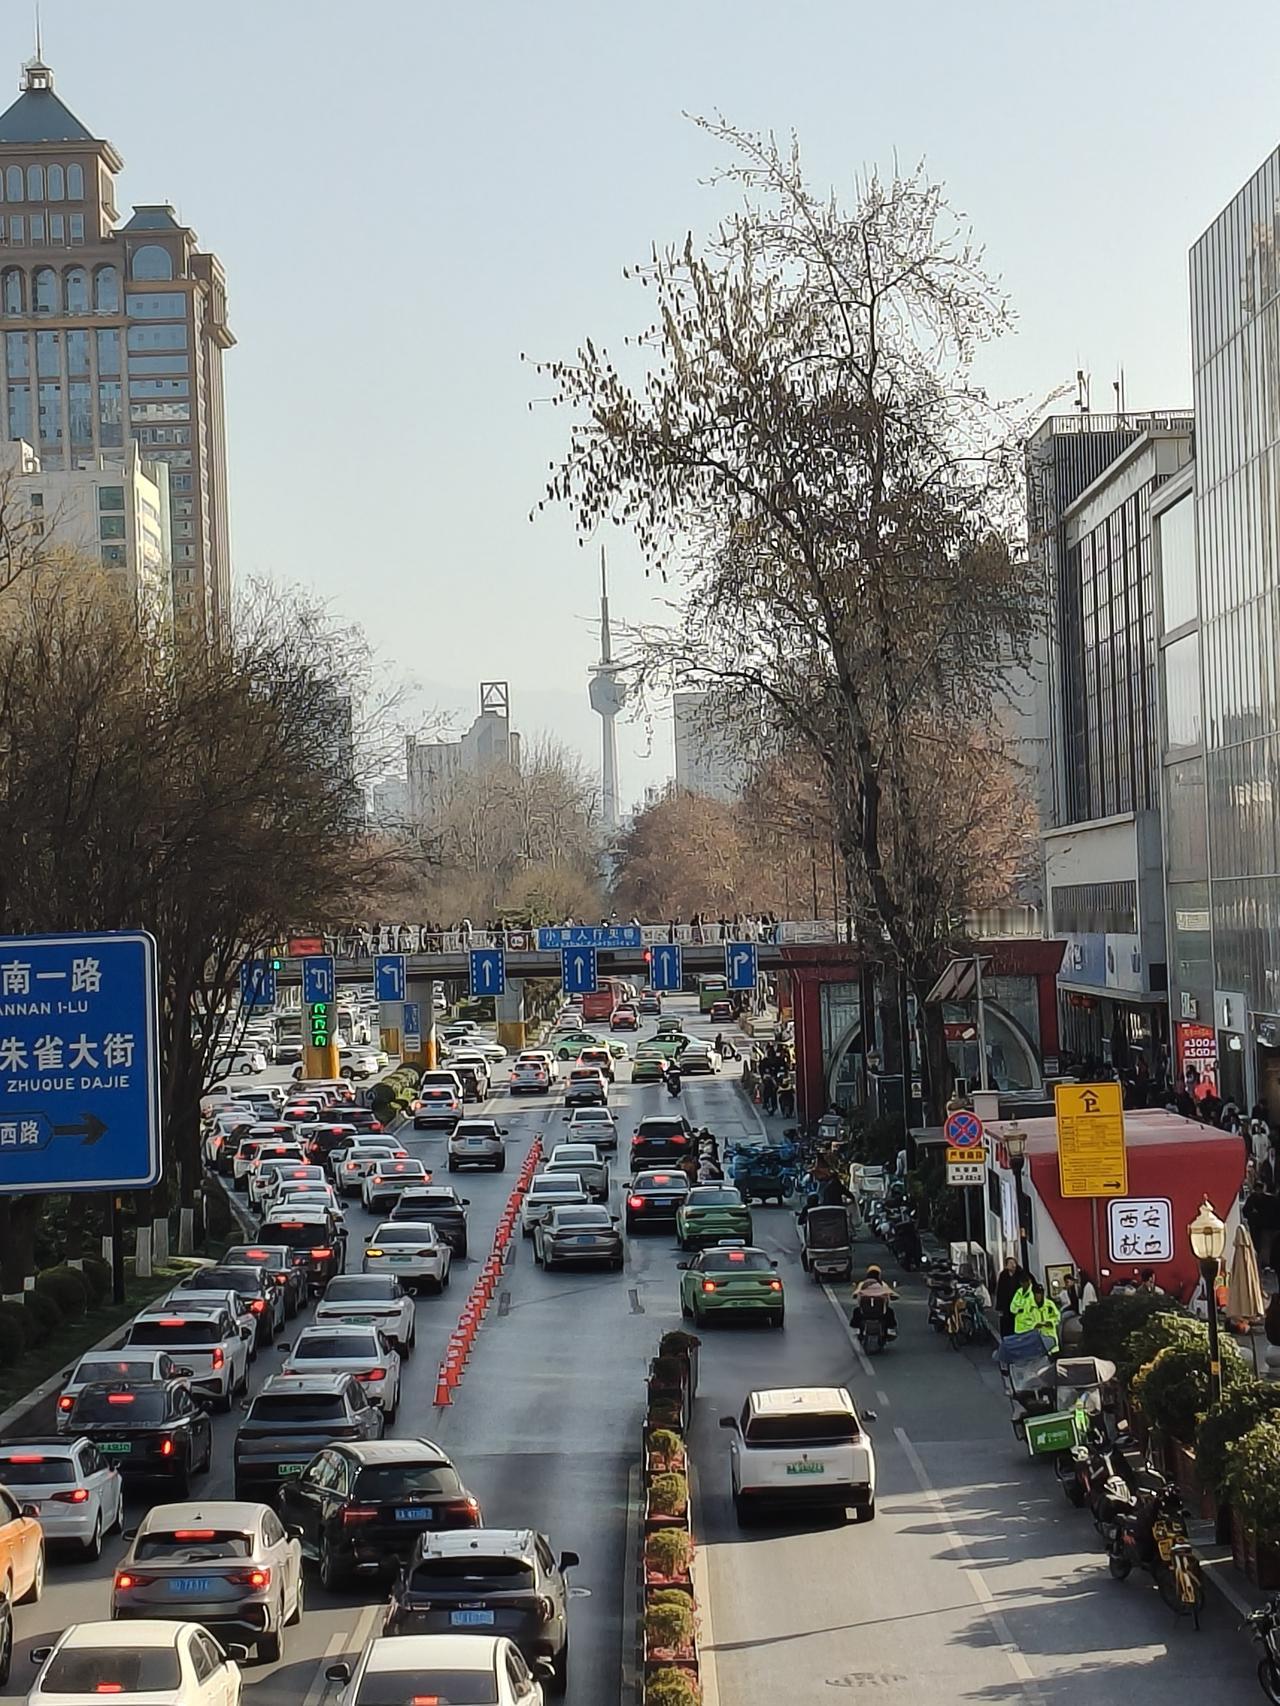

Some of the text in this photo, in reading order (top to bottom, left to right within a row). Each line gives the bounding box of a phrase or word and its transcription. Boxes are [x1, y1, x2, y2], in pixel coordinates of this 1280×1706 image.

[1, 957, 102, 996] 南一路
[0, 1033, 135, 1073] 朱雀大街
[7, 1076, 130, 1092] ZHUQUE DAJIE
[0, 1120, 39, 1145] 西路
[1119, 1206, 1160, 1228] 西安
[1120, 1234, 1162, 1255] 献血
